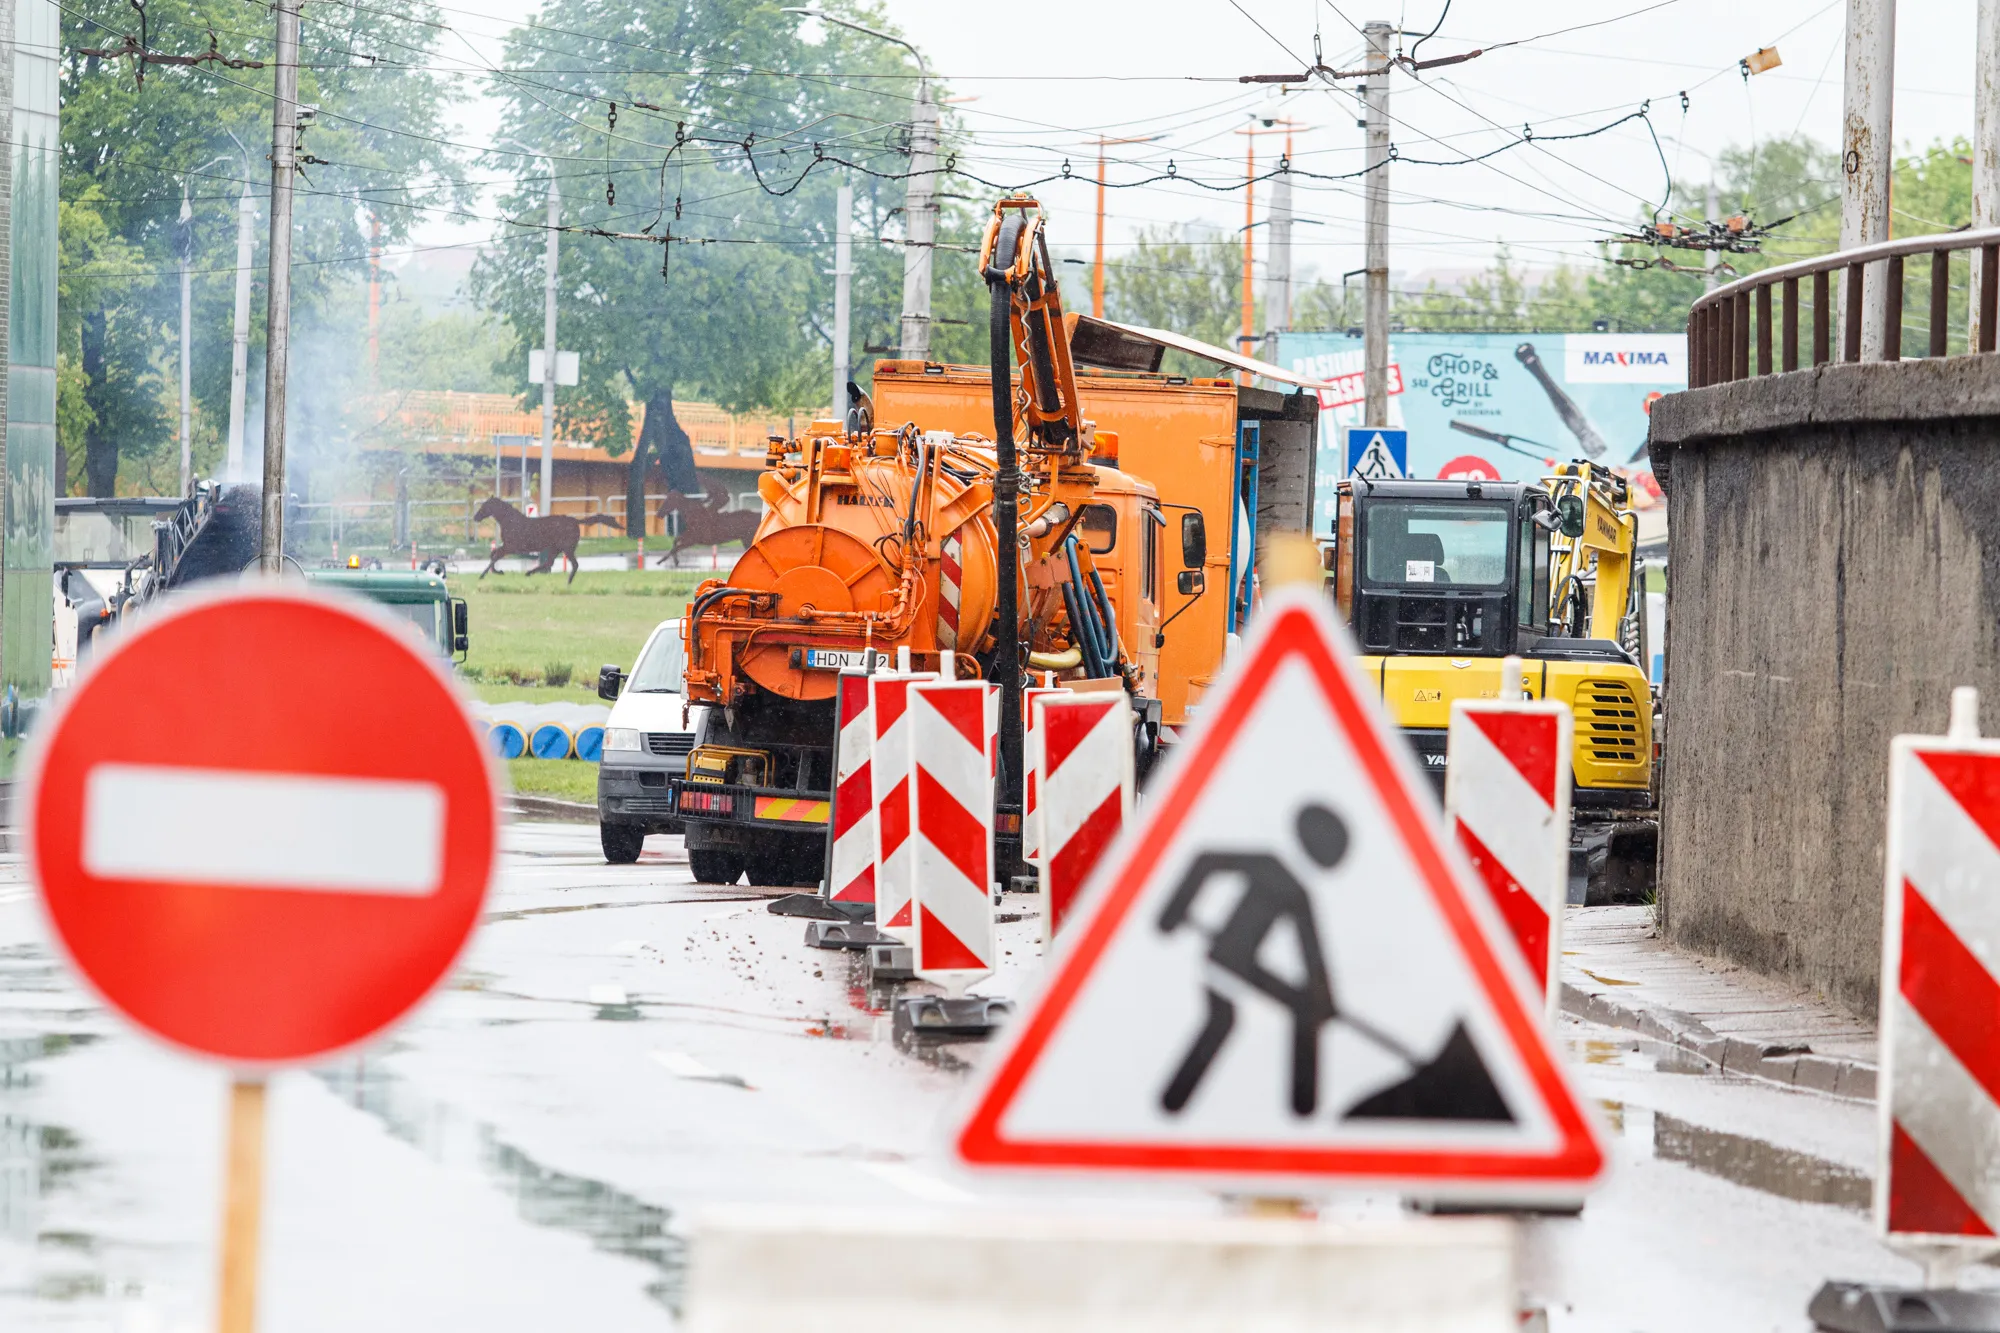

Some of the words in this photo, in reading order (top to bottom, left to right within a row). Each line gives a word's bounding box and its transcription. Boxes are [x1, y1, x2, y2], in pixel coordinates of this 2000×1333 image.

[1842, 150, 1859, 175] 0
[1584, 351, 1669, 367] MAXIMA
[1431, 377, 1492, 407] GRILL
[817, 652, 849, 667] HDN
[859, 654, 887, 668] 42
